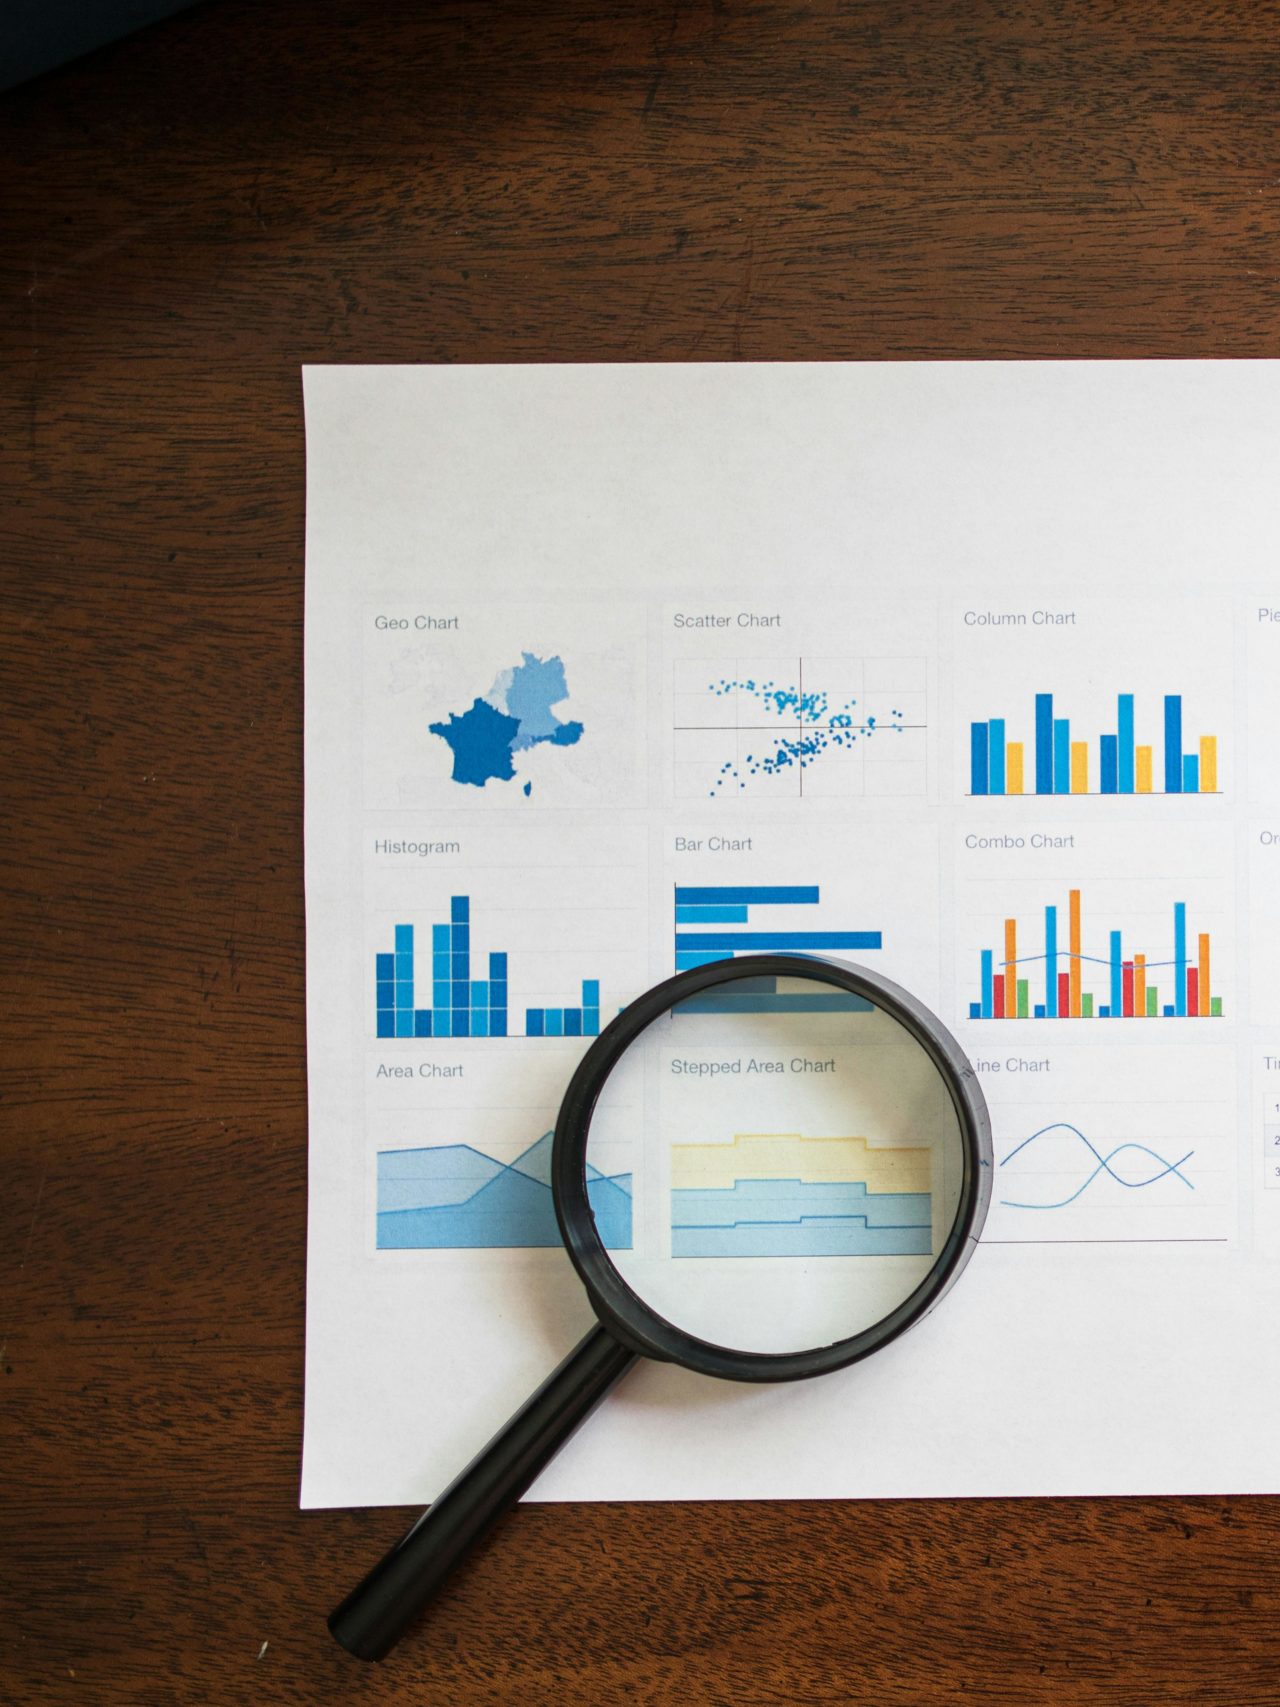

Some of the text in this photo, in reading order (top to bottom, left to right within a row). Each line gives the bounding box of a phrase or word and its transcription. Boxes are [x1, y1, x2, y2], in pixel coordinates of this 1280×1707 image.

[375, 616, 459, 630] Geo Chart
[674, 613, 781, 628] Scatter Chart
[964, 611, 1076, 626] Column Chart
[376, 840, 460, 857] Histogram
[675, 837, 752, 851] Bar Chart
[965, 834, 1075, 849] Combo Chart
[377, 1063, 464, 1078] Area Chart
[672, 1057, 836, 1077] Stepped Area Chart
[1005, 1057, 1050, 1073] Chart
[1274, 1135, 1280, 1146] 2
[1275, 1166, 1280, 1177] 3
